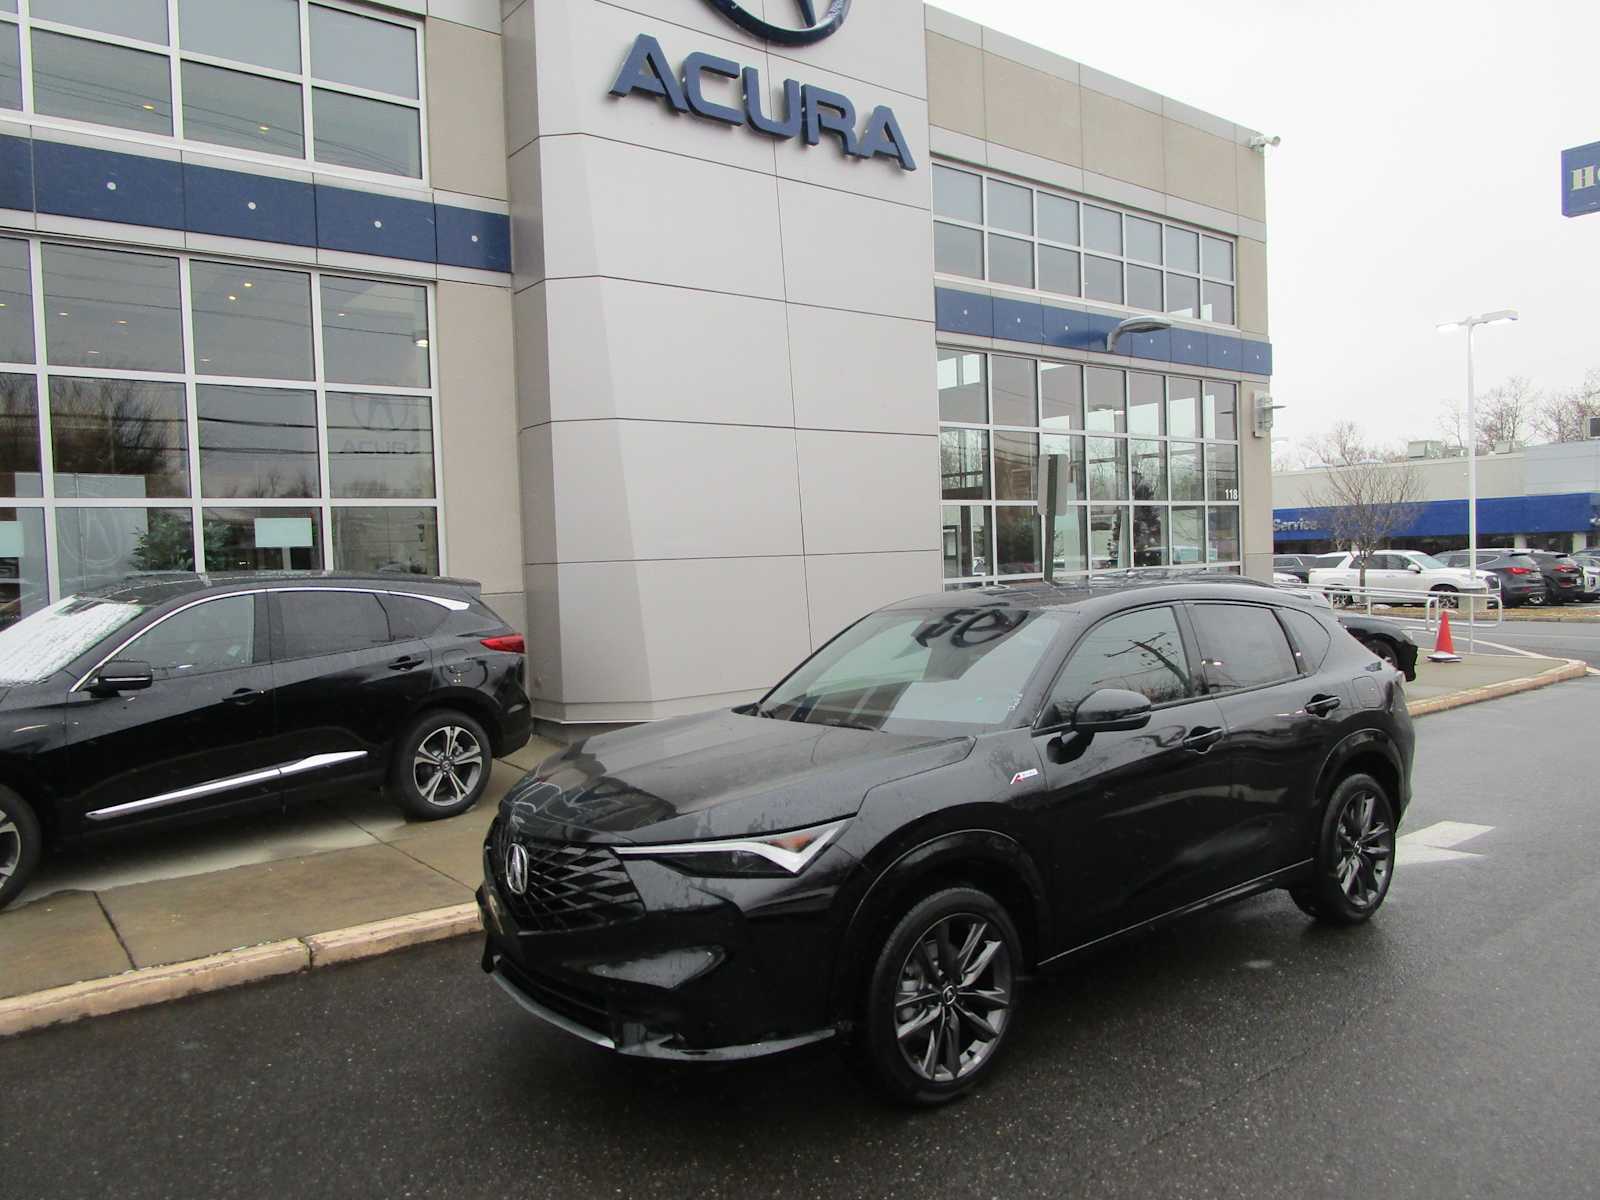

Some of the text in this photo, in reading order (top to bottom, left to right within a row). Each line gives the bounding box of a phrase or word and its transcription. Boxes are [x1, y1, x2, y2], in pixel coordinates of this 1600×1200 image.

[609, 33, 917, 171] ACURA
[1570, 164, 1600, 191] H
[1225, 488, 1237, 500] 118
[1272, 517, 1318, 532] Service
